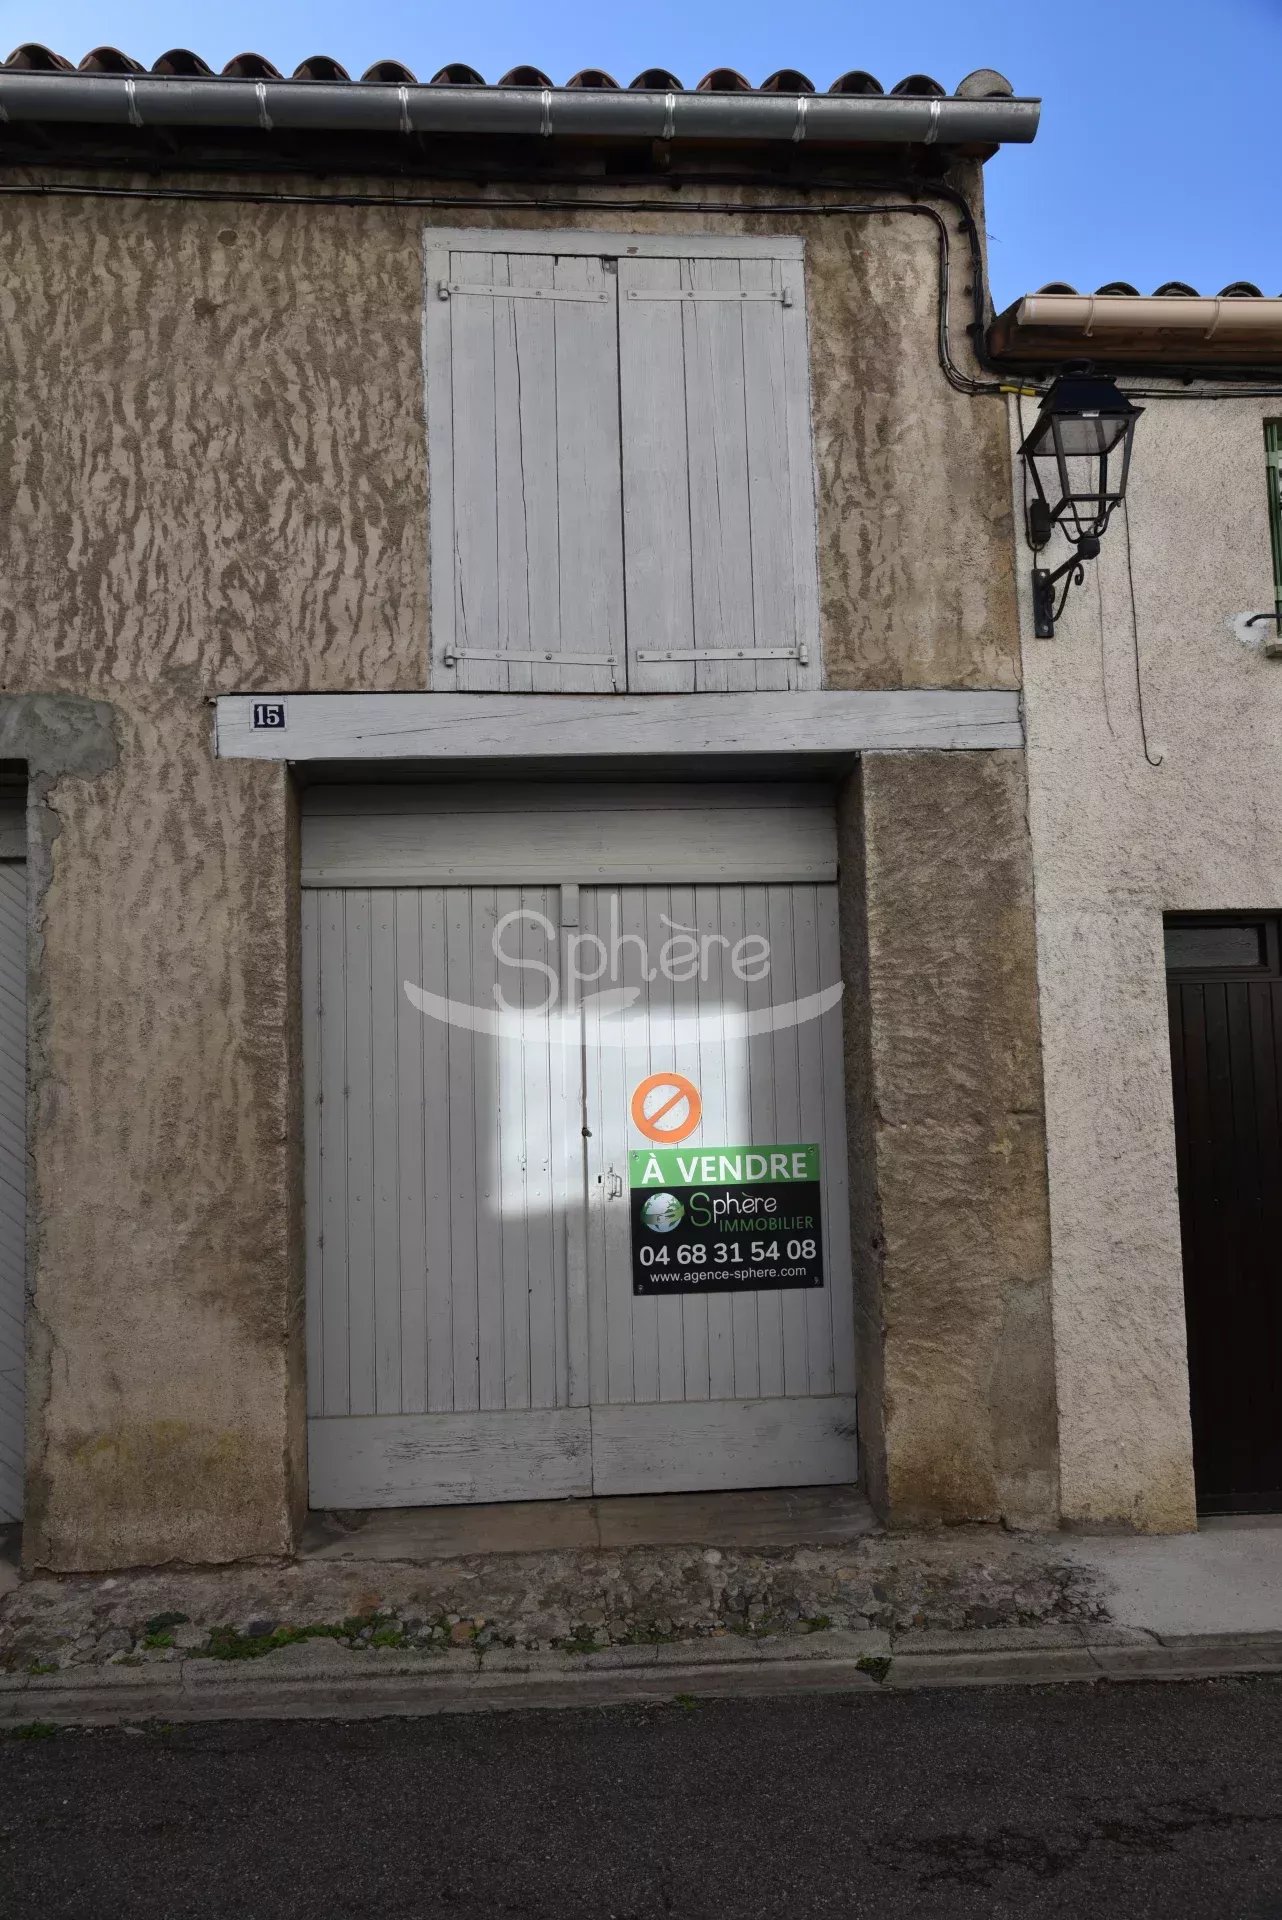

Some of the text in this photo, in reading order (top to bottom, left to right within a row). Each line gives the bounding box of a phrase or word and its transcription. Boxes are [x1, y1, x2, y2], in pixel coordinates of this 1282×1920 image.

[256, 705, 280, 725] 15
[641, 1152, 808, 1184] À VENDRE
[689, 1192, 777, 1227] Sphère
[719, 1216, 814, 1233] IMMOBILIER
[639, 1239, 817, 1266] 04 68 31 54 08
[650, 1266, 807, 1283] www.agence-sphere.com
